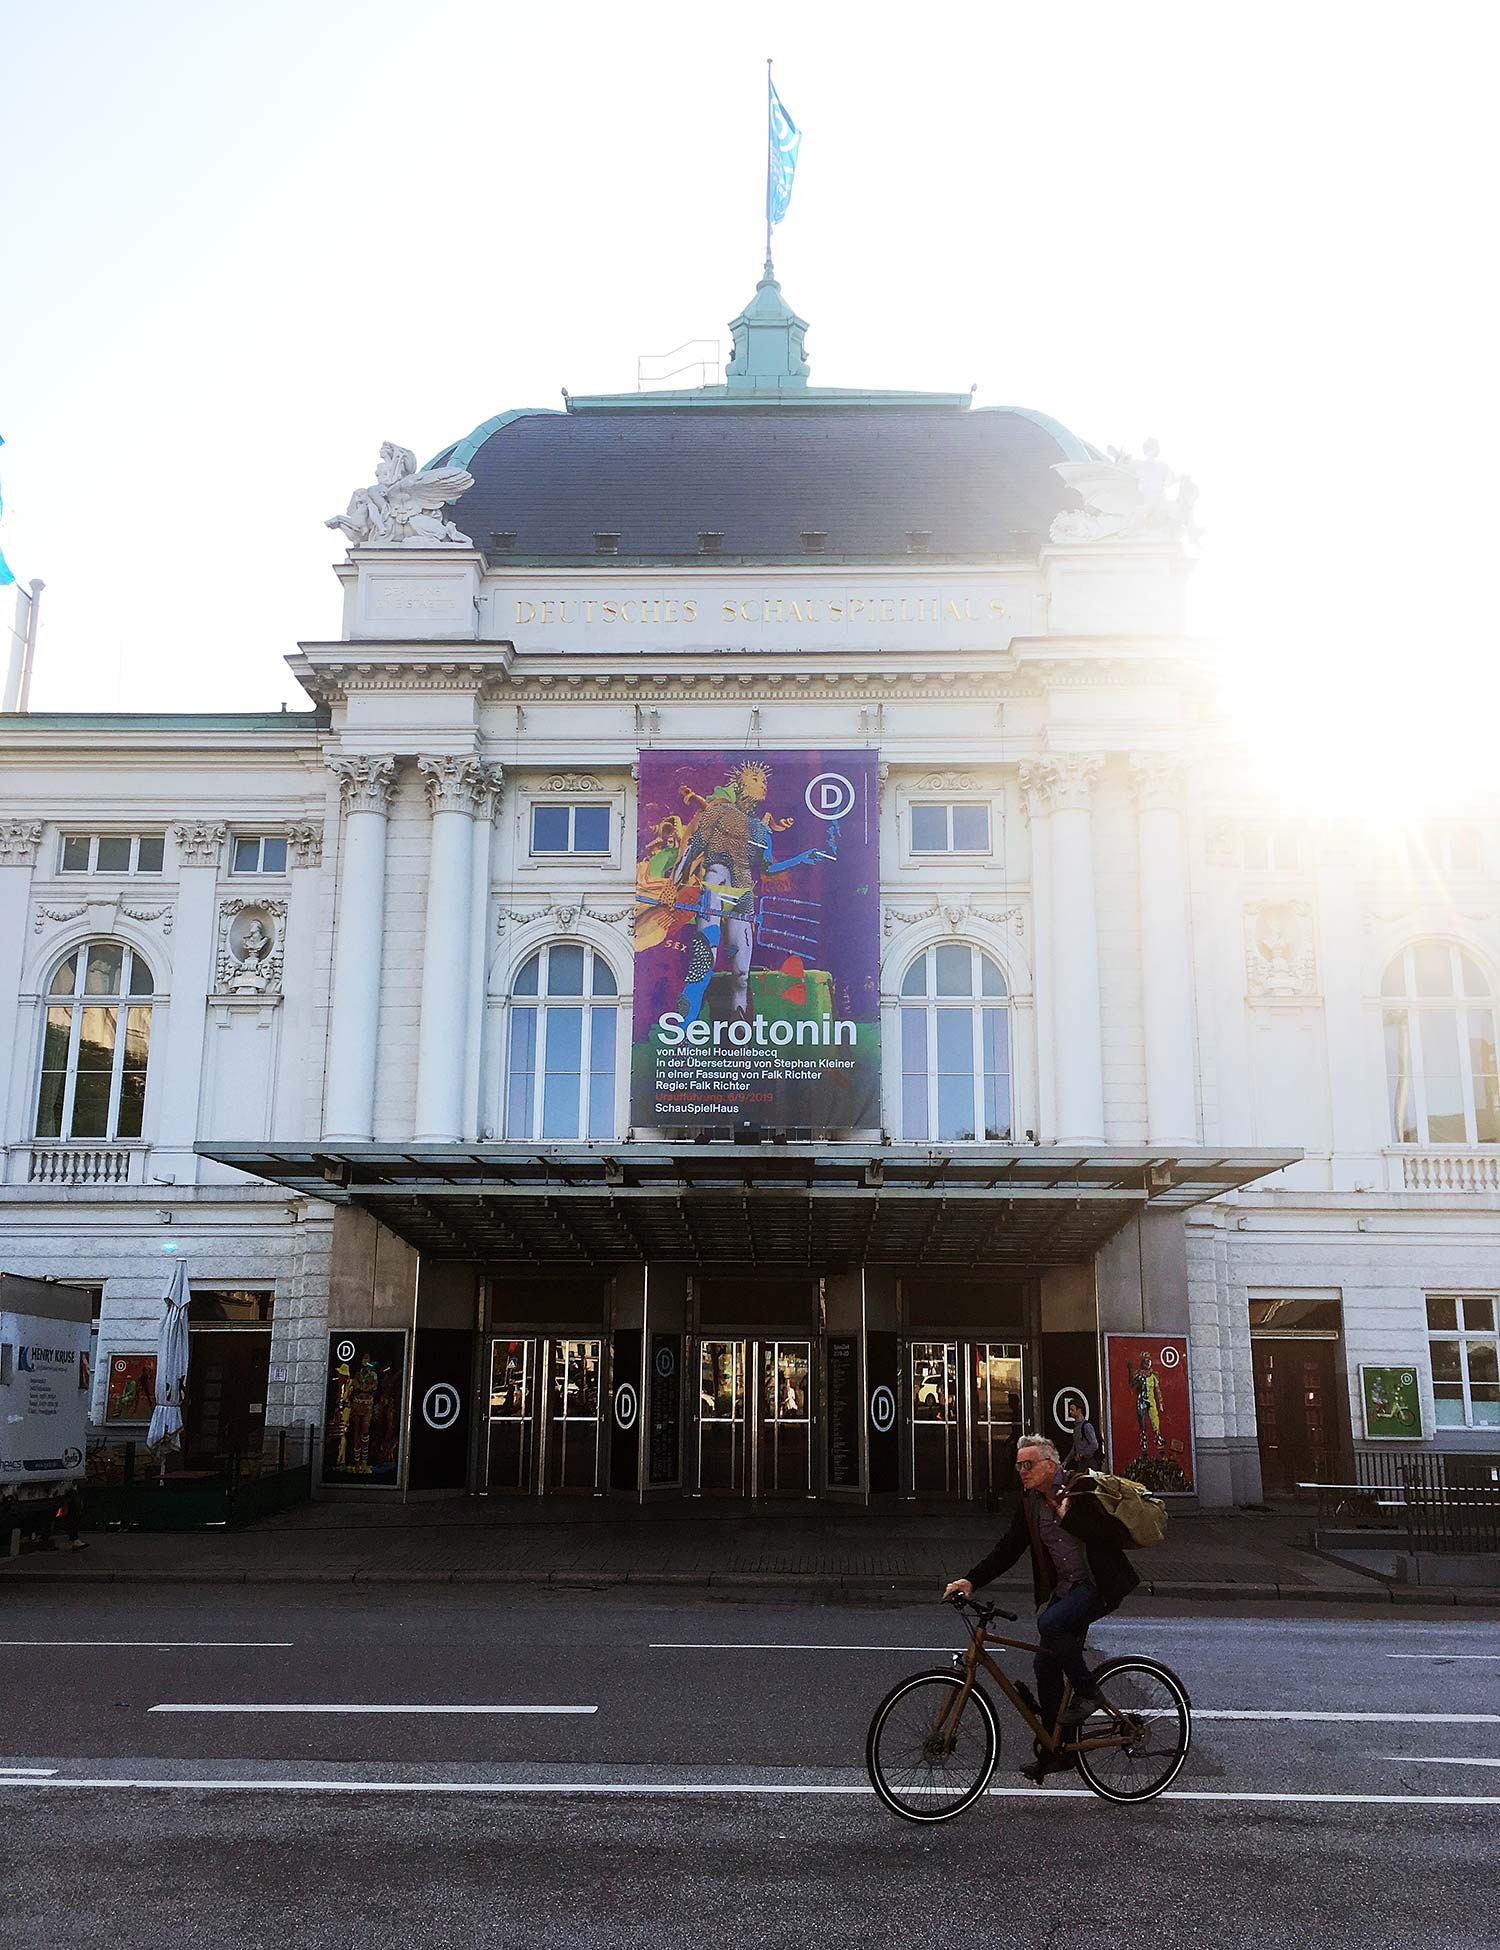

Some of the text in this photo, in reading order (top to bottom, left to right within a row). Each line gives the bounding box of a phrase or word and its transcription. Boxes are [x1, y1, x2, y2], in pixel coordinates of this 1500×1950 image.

[514, 600, 698, 625] DEUTSCHES
[821, 784, 843, 809] D
[664, 939, 688, 953] SEX
[657, 1011, 857, 1046] Serotonin
[656, 1048, 778, 1059] von Michel Houellebecq
[656, 1057, 856, 1070] in der Übersetzung von Stephan Kleiner
[656, 1069, 823, 1081] in einer Fassung von Falk Richter
[655, 1080, 751, 1092] Regie: Falk Richter
[727, 1092, 774, 1103] 6/9/2019
[654, 1103, 740, 1115] SchauSpielHaus
[31, 1347, 75, 1364] HENRY KRUSE
[342, 1345, 351, 1357] D
[1165, 1351, 1175, 1363] D
[661, 1354, 671, 1370] D
[434, 1394, 452, 1418] D
[621, 1394, 632, 1418] D
[878, 1396, 890, 1421] D
